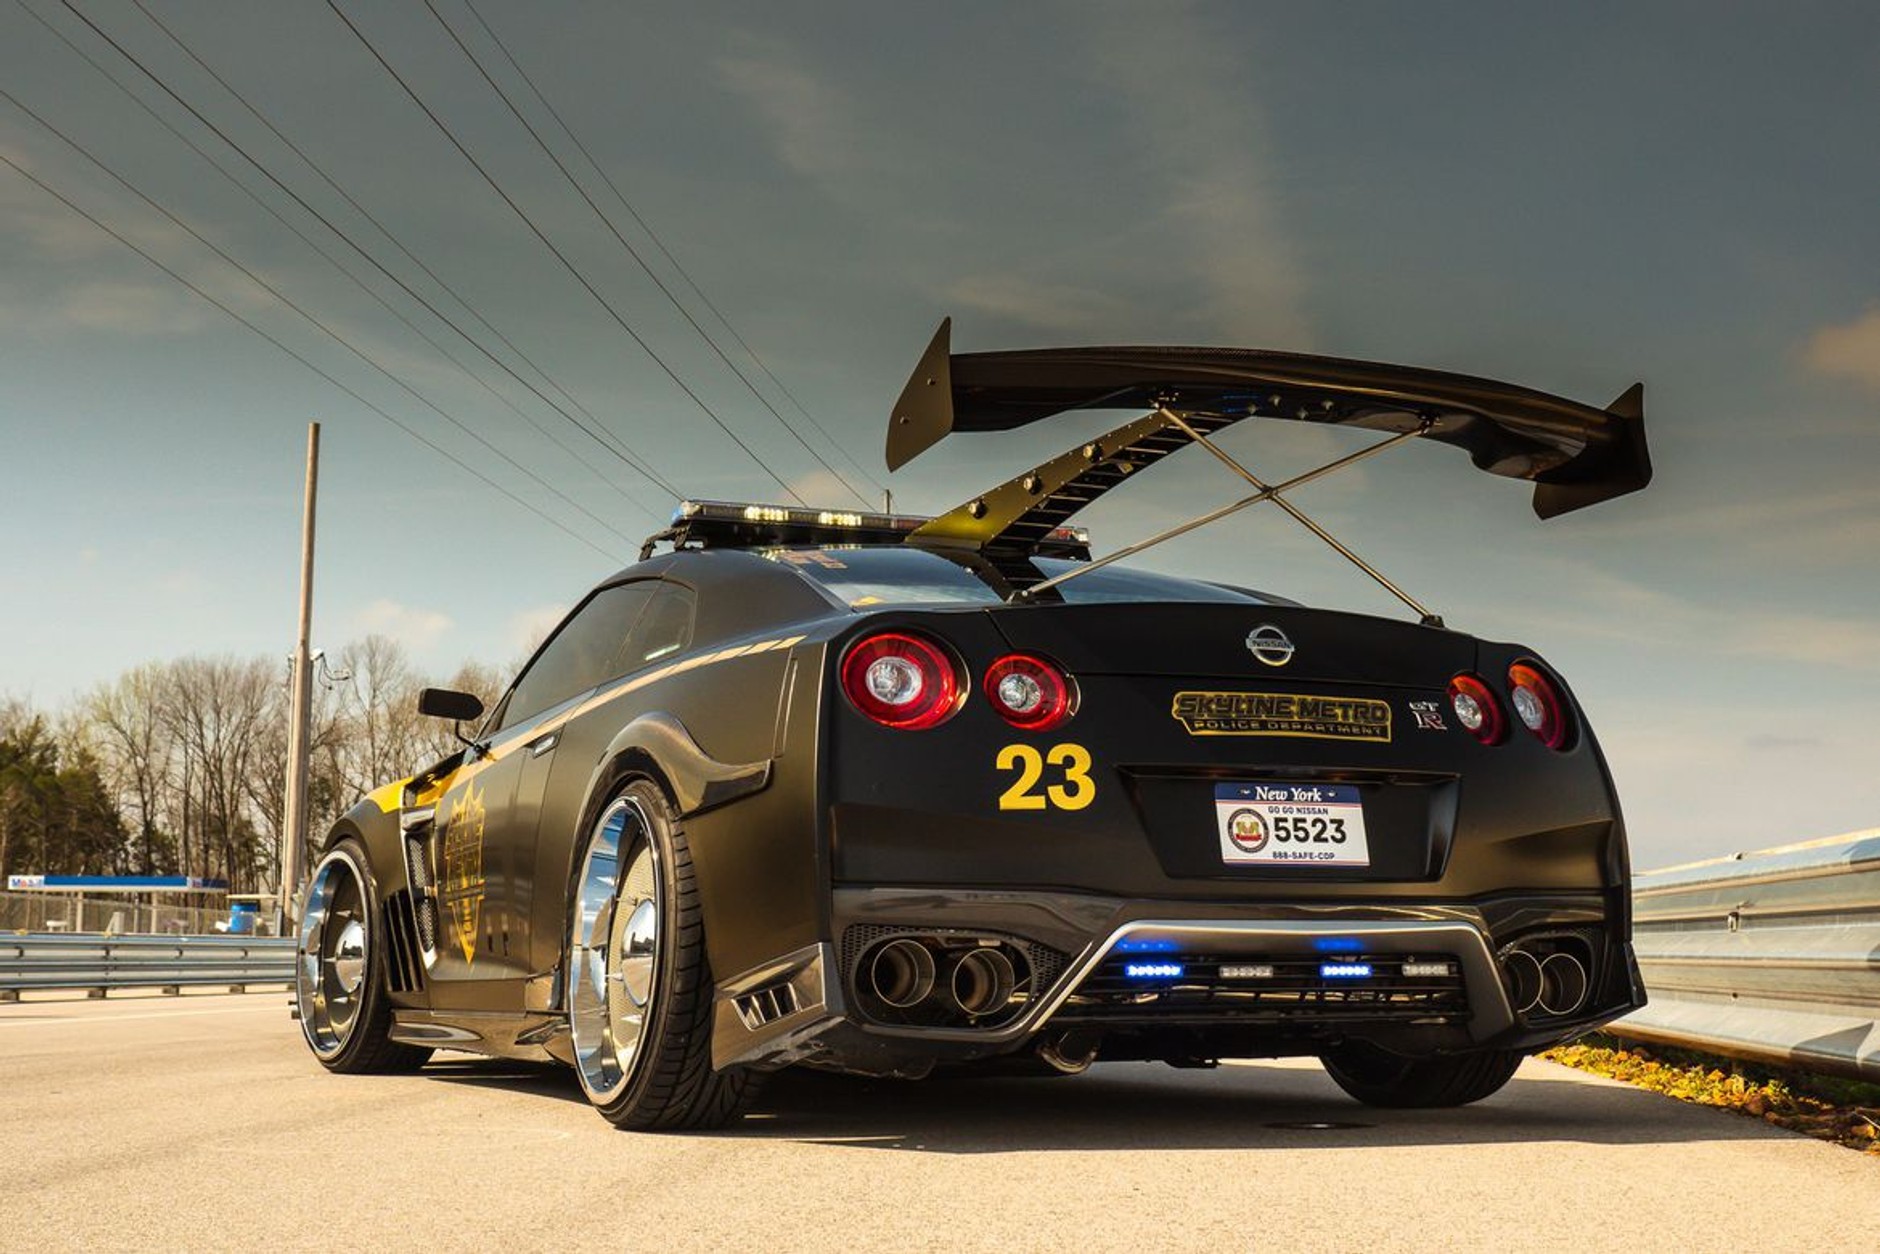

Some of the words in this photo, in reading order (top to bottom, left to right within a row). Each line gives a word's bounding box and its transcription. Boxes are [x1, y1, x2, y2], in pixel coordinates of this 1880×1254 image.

[1252, 639, 1291, 649] NISSAN
[1178, 695, 1294, 718] SKYLINE
[1297, 698, 1388, 722] METRO
[1194, 720, 1260, 730] POLICE
[1267, 721, 1381, 735] DEPARTMENT
[996, 743, 1096, 810] 23
[1255, 786, 1288, 801] New
[1290, 787, 1323, 802] York
[1268, 806, 1280, 815] GO
[1282, 806, 1295, 815] GO
[1296, 807, 1329, 815] NISSAN
[1274, 817, 1347, 844] 5523
[1272, 851, 1335, 860] 888-SAFE-COP
